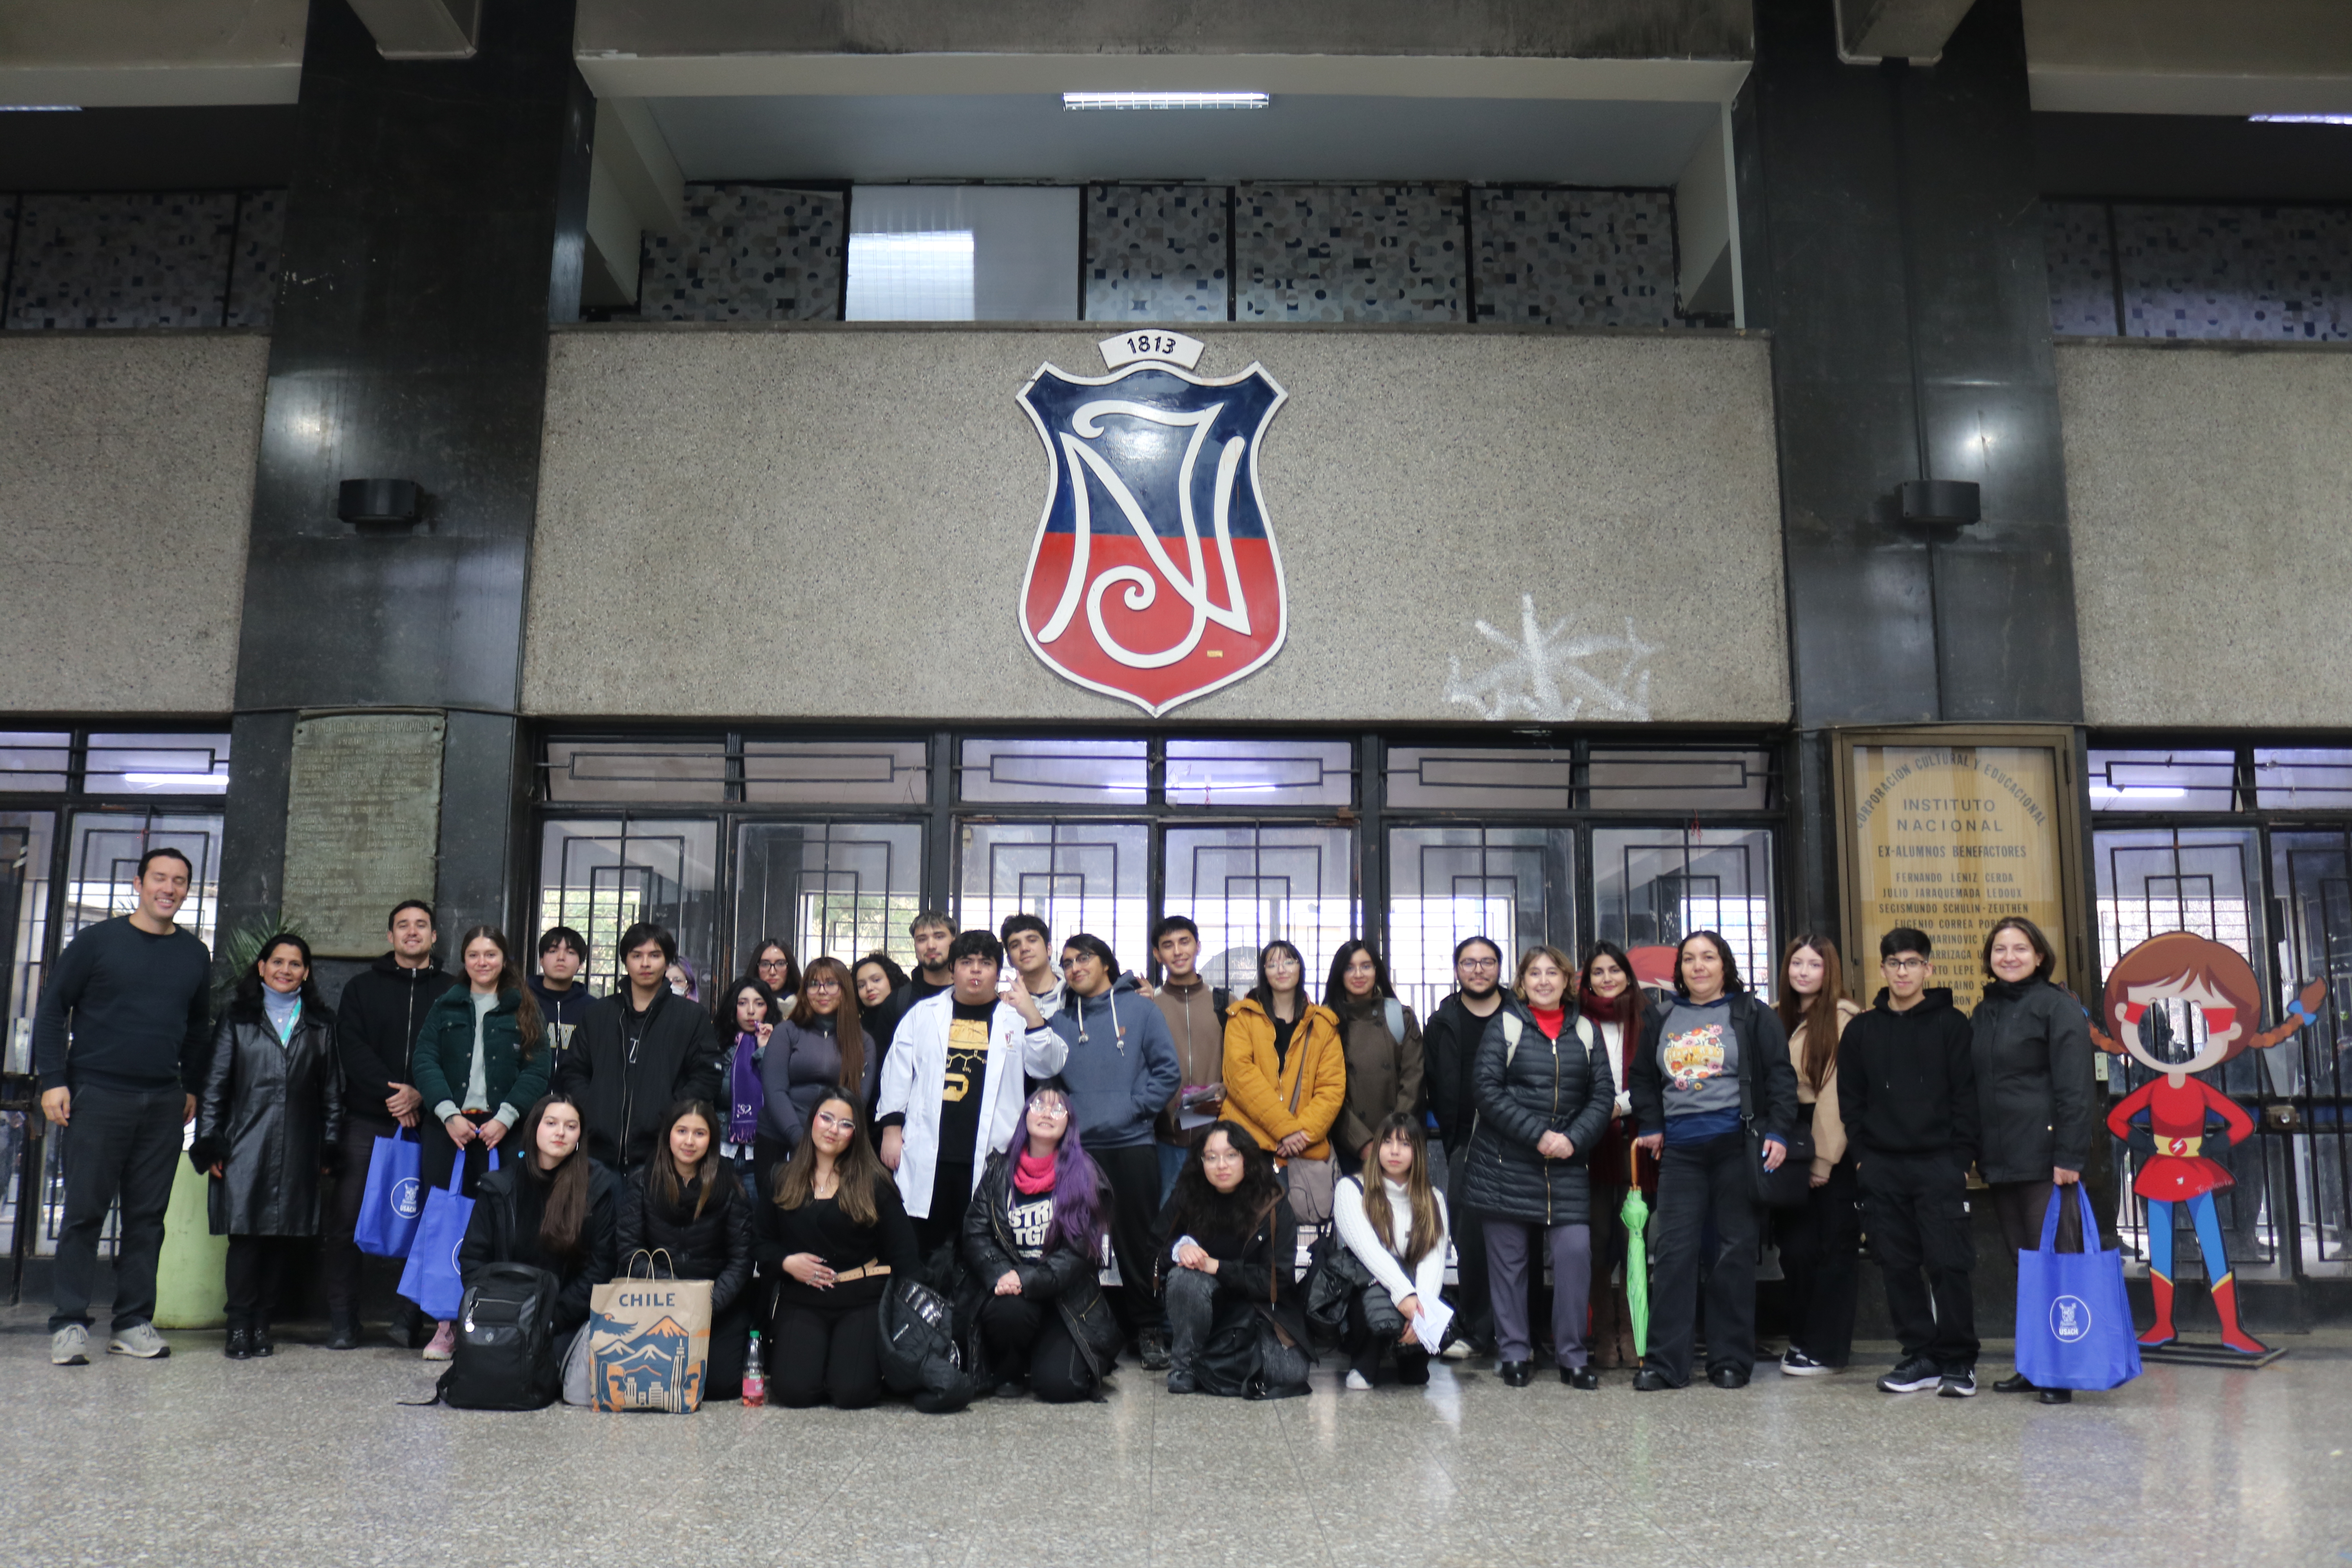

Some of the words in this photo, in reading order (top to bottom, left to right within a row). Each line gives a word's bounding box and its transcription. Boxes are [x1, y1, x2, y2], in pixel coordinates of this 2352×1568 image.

[1127, 336, 1176, 354] 1813
[1857, 764, 1911, 829] CORPORACION
[1915, 752, 1969, 769] CULTURAL
[1974, 758, 1981, 770] Y
[1984, 764, 2046, 827] EDUCACIONAL
[1904, 799, 1996, 812] INSTITUTO
[1897, 819, 2003, 832] NACIONAL
[1878, 845, 1945, 857] EX-ALUMNOS
[1953, 845, 2026, 857] BENEFACTORES
[1896, 873, 1942, 882] FERNANDO
[1951, 873, 1977, 882] LENIZ
[1985, 873, 2013, 882] CERDA
[1883, 888, 1908, 898] JULIO
[1916, 888, 1980, 899] JARAQUEMADA
[1987, 888, 2022, 898] LEDOUX
[1879, 904, 1937, 913] SEGISMUNDO
[1895, 919, 1933, 929] EUGENIO
[1939, 919, 1973, 929] CORREA
[1929, 935, 1977, 944] MARINOVIC
[1954, 965, 1974, 975] LEPE
[1937, 981, 1974, 990] ALCAINO
[400, 1205, 416, 1213] USACH
[619, 1293, 675, 1307] CHILE
